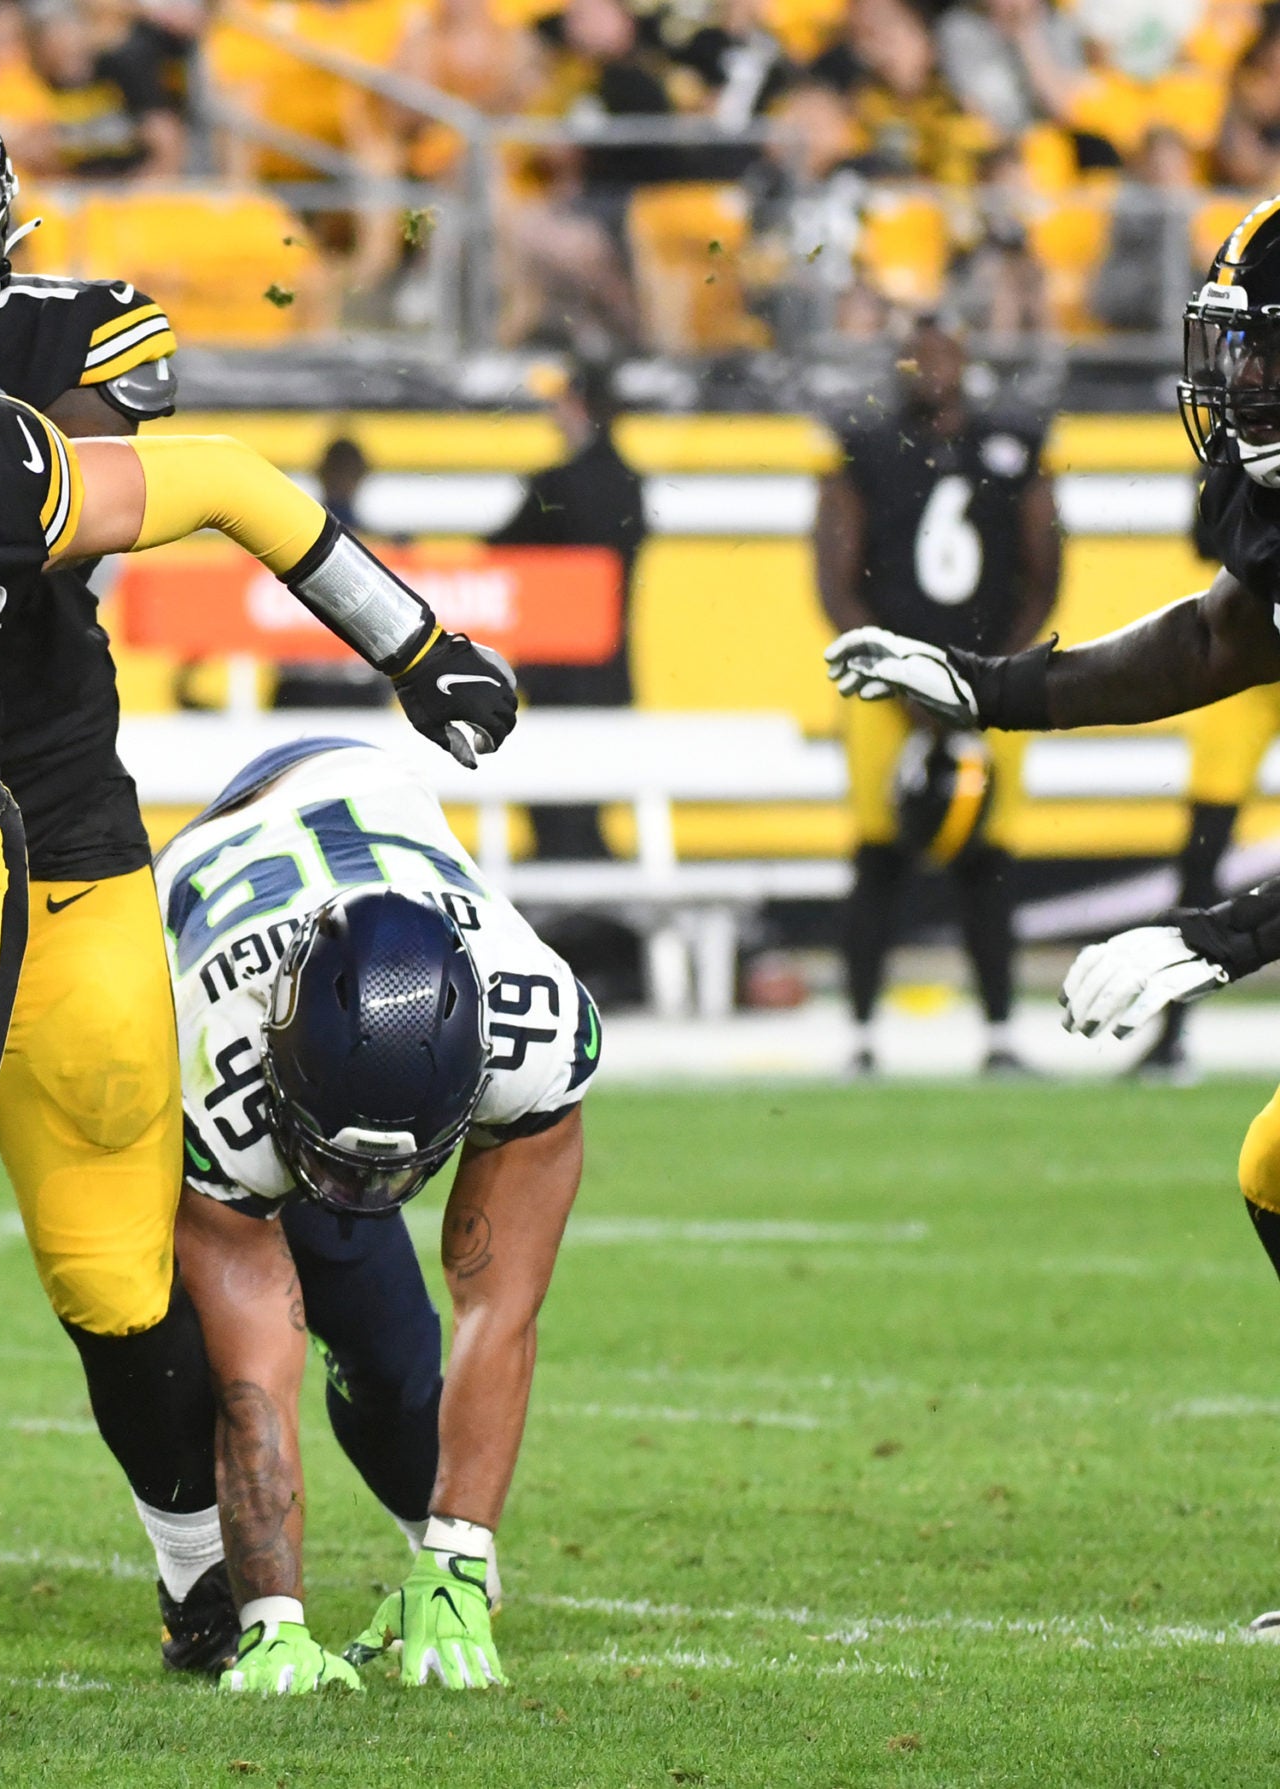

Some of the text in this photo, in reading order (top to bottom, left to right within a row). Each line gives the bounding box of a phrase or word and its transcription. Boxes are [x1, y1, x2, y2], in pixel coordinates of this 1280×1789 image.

[914, 473, 983, 606] 6
[165, 796, 490, 981] 49
[487, 970, 559, 1071] 49
[204, 1036, 274, 1151] 49
